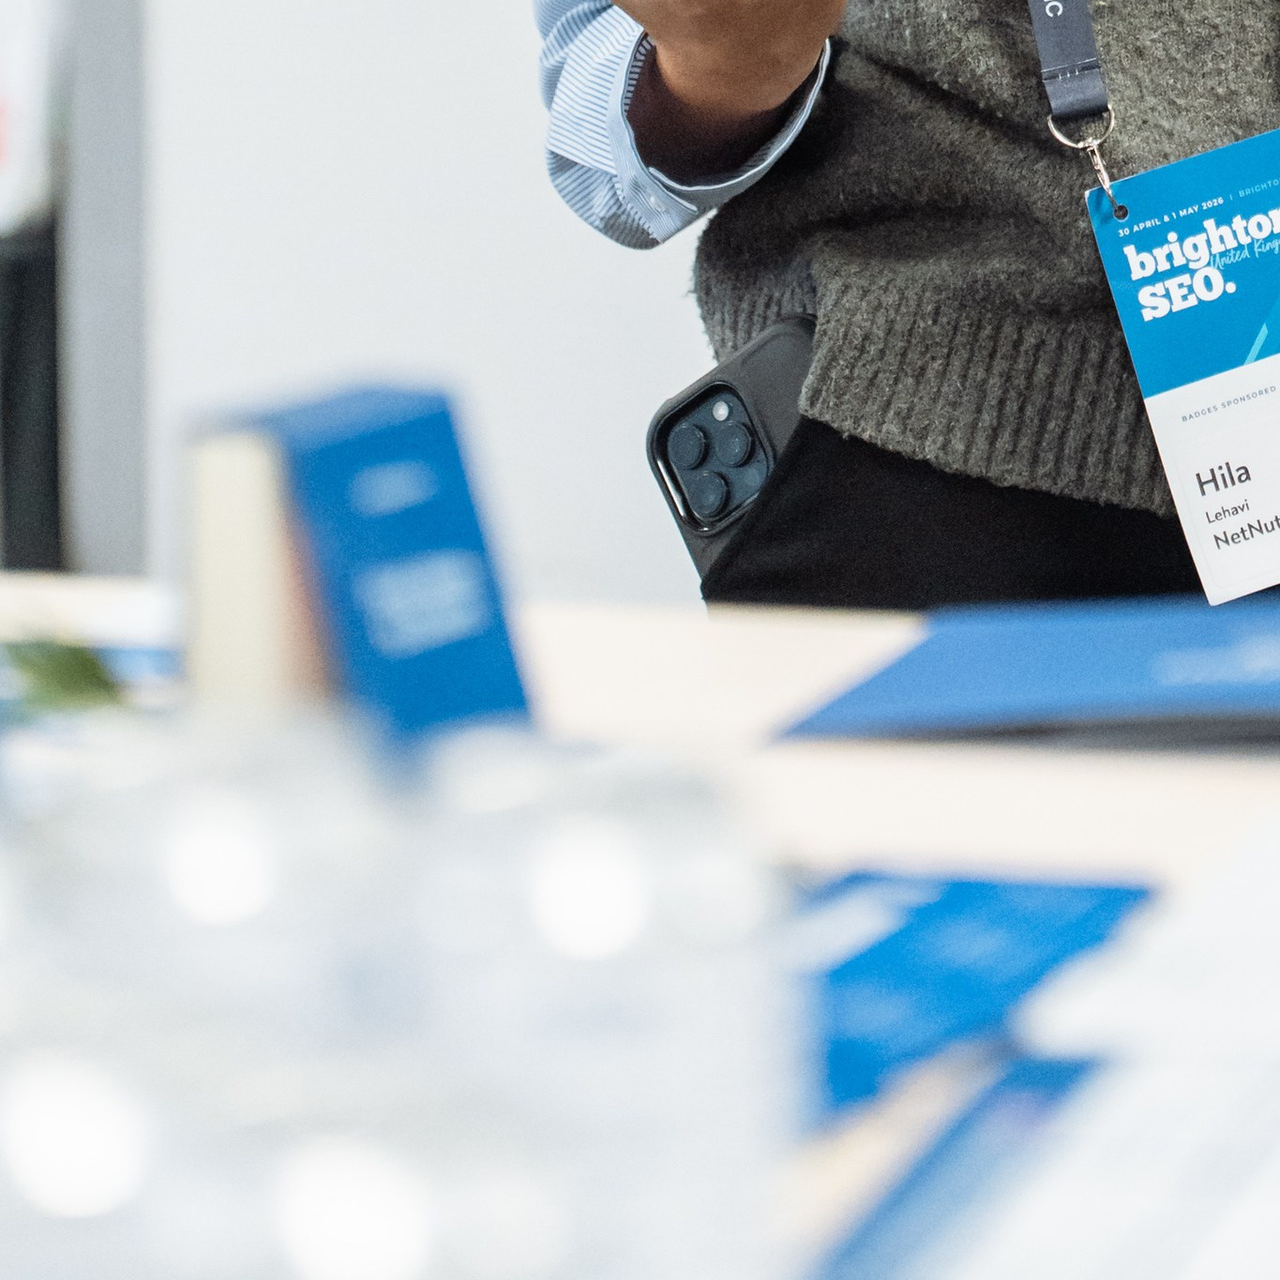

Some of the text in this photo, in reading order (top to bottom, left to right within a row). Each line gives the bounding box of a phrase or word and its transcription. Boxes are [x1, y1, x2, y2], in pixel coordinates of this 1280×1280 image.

[1117, 228, 1131, 238] 30
[1133, 219, 1162, 233] APRIL
[1163, 214, 1171, 223] &
[1179, 205, 1200, 217] MAY
[1201, 196, 1225, 211] 2026
[1209, 245, 1251, 271] United
[1137, 266, 1237, 323] SEO.
[1181, 405, 1219, 423] BADGES
[1221, 385, 1278, 410] SPONSORED
[1195, 461, 1252, 497] Hila
[1205, 499, 1251, 525] Lehavi
